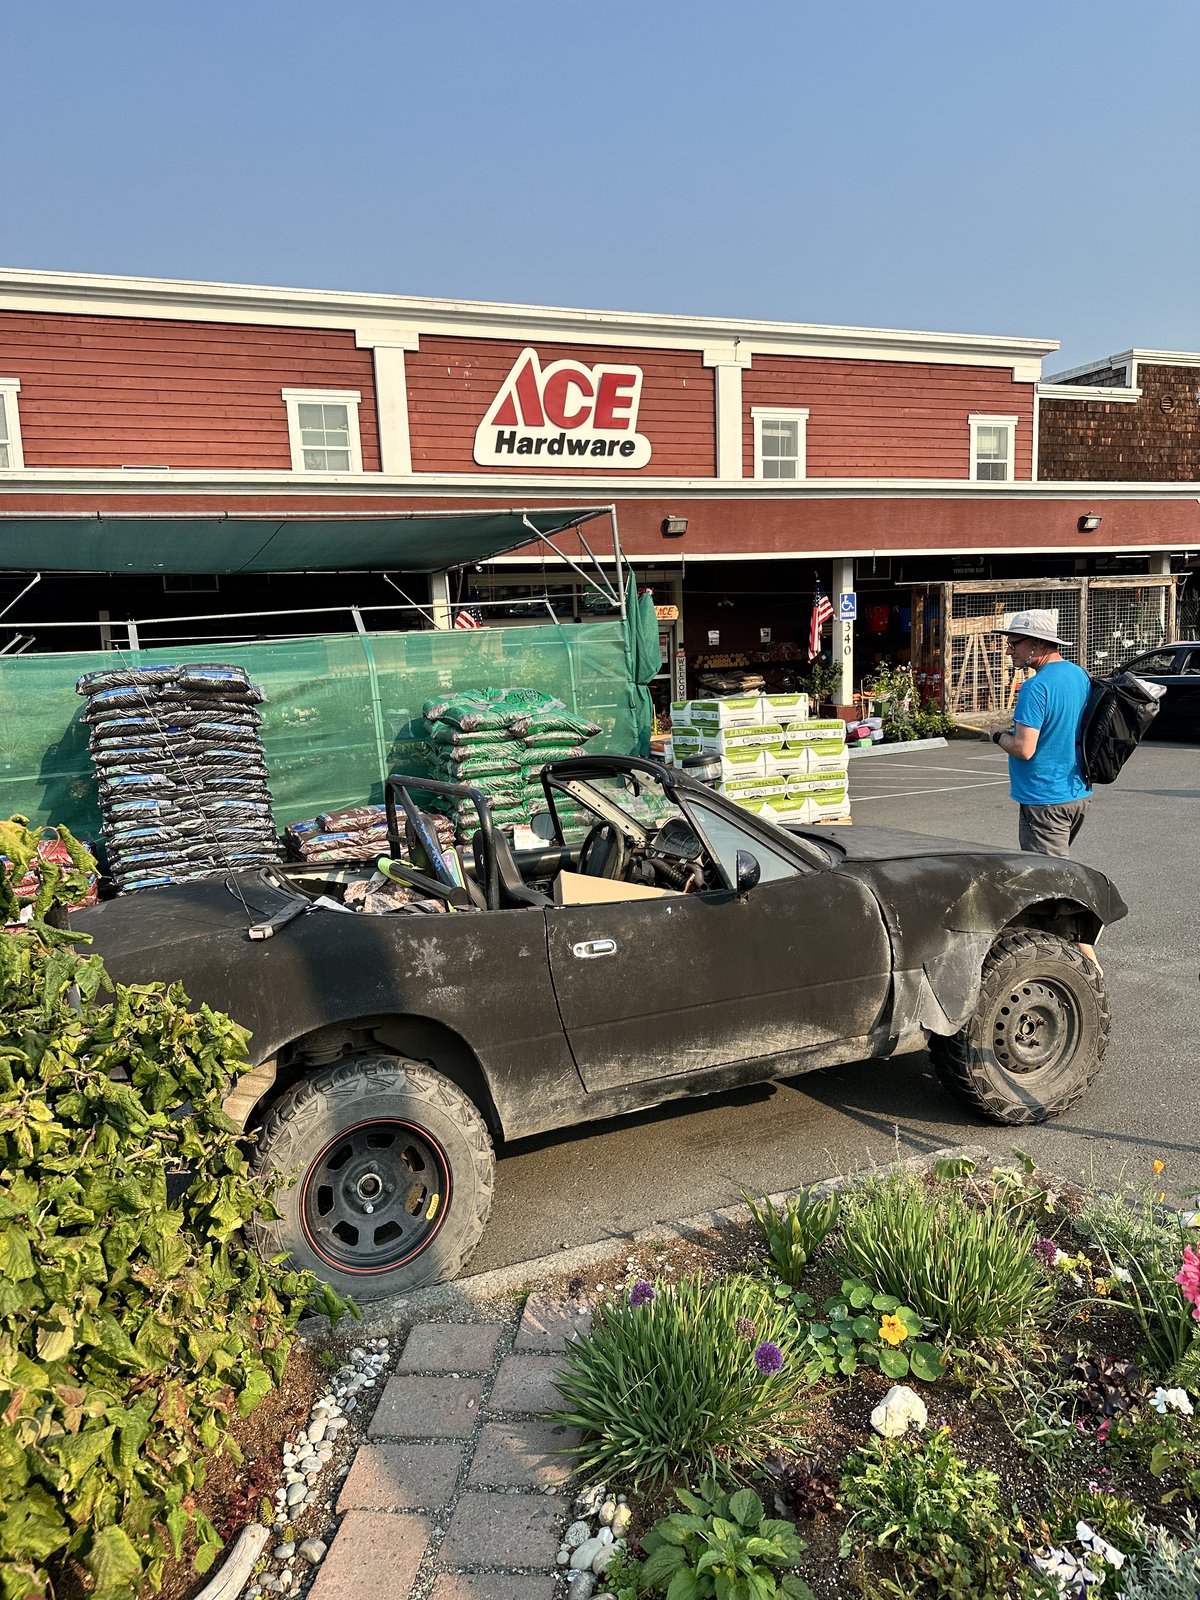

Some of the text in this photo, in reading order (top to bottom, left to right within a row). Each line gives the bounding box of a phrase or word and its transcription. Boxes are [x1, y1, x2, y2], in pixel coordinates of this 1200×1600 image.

[491, 357, 637, 429] ACE
[495, 430, 636, 457] Hardware
[844, 621, 852, 656] 340
